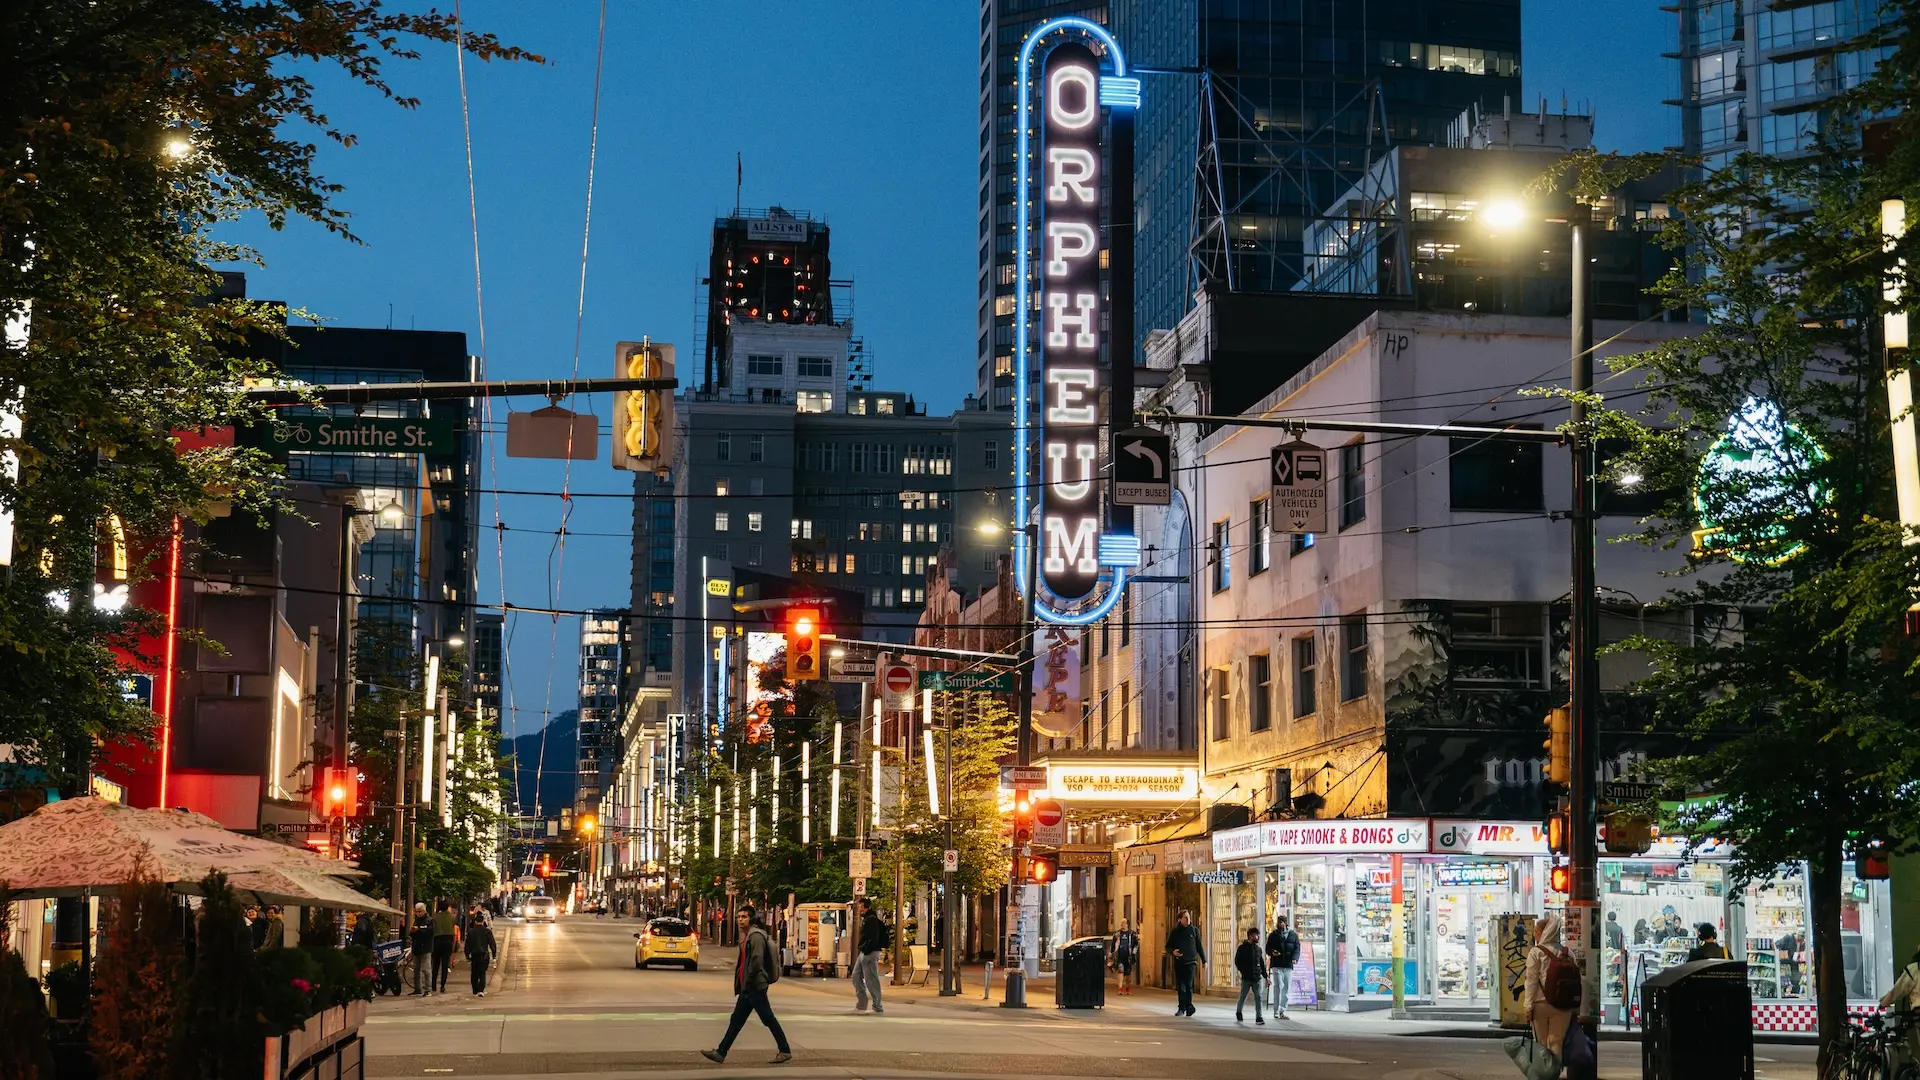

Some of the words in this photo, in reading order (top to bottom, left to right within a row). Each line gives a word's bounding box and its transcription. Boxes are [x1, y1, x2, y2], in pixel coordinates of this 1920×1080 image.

[1045, 65, 1097, 573] ORPHEUM
[318, 424, 397, 446] Smithe
[403, 425, 433, 447] St.
[1118, 488, 1142, 497] EXCEPT
[1146, 489, 1167, 497] BUSES
[1275, 488, 1323, 498] AUTHORIZED
[1282, 499, 1317, 508] VEHICLES
[1290, 509, 1309, 518] ONLY
[945, 675, 985, 687] Smithe
[989, 677, 1004, 688] St.
[1115, 776, 1185, 784] EXTRAORDINARY
[1067, 784, 1083, 792] VSO
[1093, 784, 1139, 792] 2023-2024
[1606, 784, 1651, 798] Smithe
[280, 824, 307, 832] Smithe
[1478, 825, 1520, 841] MR.
[1267, 830, 1278, 845] MR.
[1280, 829, 1298, 845] VAPE
[1301, 828, 1335, 845] SMOKE
[1340, 828, 1347, 844] &
[1352, 828, 1394, 844] BONGS
[1193, 876, 1238, 884] EXCHANGE
[1373, 871, 1391, 884] AT
[1440, 869, 1461, 880] VAPE
[1853, 886, 1866, 898] ATM
[1367, 976, 1392, 987] DRUMSTIC
